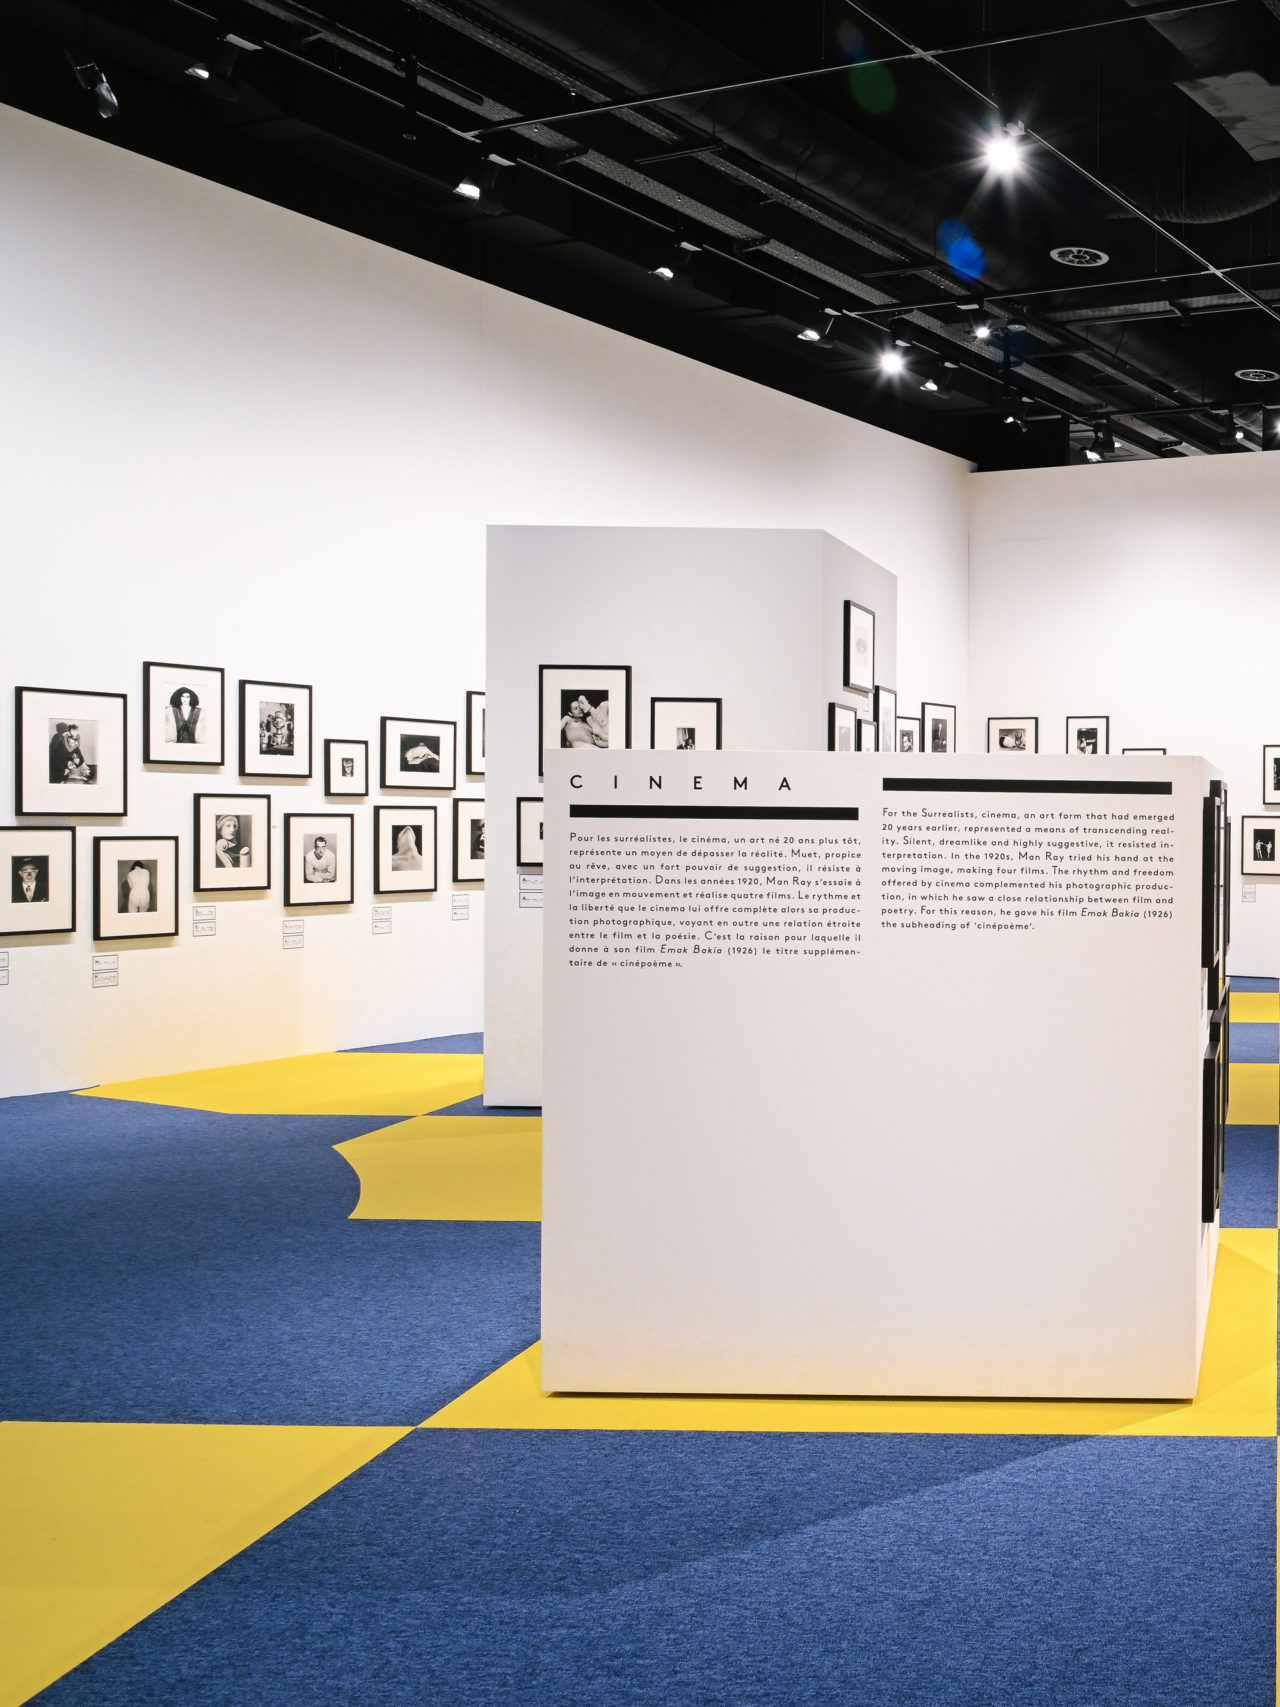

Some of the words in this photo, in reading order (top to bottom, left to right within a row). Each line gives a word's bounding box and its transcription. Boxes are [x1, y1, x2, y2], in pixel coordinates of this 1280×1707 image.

[570, 775, 791, 790] CINEMA
[883, 808, 897, 817] For
[922, 808, 977, 818] Surrealists,
[982, 811, 1020, 819] cinema,
[1133, 813, 1174, 822] emerged
[926, 824, 960, 832] earlier,
[964, 825, 1022, 834] represented
[1083, 826, 1147, 836] transcending
[570, 832, 593, 842] Pour
[819, 837, 838, 846] plus
[882, 837, 899, 846] ity.
[903, 836, 935, 846] Silent,
[1013, 839, 1043, 848] highly
[1047, 840, 1102, 849] suggestive,
[570, 848, 622, 858] représente
[691, 850, 734, 859] dépasser
[791, 849, 820, 859] Muet,
[825, 851, 861, 860] propice
[882, 852, 946, 860] terpretation.
[984, 853, 1013, 861] 1920s,
[1019, 851, 1040, 860] Man
[1046, 852, 1064, 863] Ray
[685, 864, 722, 872] pouvoir
[744, 864, 801, 873] suggestion,
[882, 865, 916, 874] moving
[921, 866, 953, 875] image,
[957, 866, 992, 876] making
[1052, 865, 1069, 875] The
[1073, 868, 1108, 877] rhythm
[656, 875, 681, 884] Dans
[738, 878, 762, 886] 1920,
[766, 876, 788, 885] Man
[793, 876, 812, 887] Ray
[921, 880, 932, 888] by
[974, 881, 1045, 890] complemented
[1066, 882, 1131, 891] photographic
[1135, 883, 1173, 892] produc-
[798, 890, 810, 899] Le
[812, 892, 848, 902] rythme
[881, 893, 904, 901] tion,
[1025, 895, 1084, 904] relationship
[732, 906, 778, 915] complète
[822, 907, 860, 915] produc-
[882, 908, 916, 916] poetry.
[921, 905, 936, 914] For
[1081, 908, 1108, 917] Emak
[1112, 908, 1139, 917] Bakia
[1144, 910, 1172, 919] (1926)
[570, 917, 589, 926] tion
[593, 918, 675, 927] photographique,
[680, 920, 713, 928] voyant
[901, 921, 956, 930] subheading
[812, 934, 850, 943] laquelle
[660, 944, 688, 954] Emak
[693, 945, 722, 954] Bakia
[728, 947, 757, 956] (1926)
[803, 948, 860, 957] supplémen-
[620, 960, 672, 969] cinépoème
